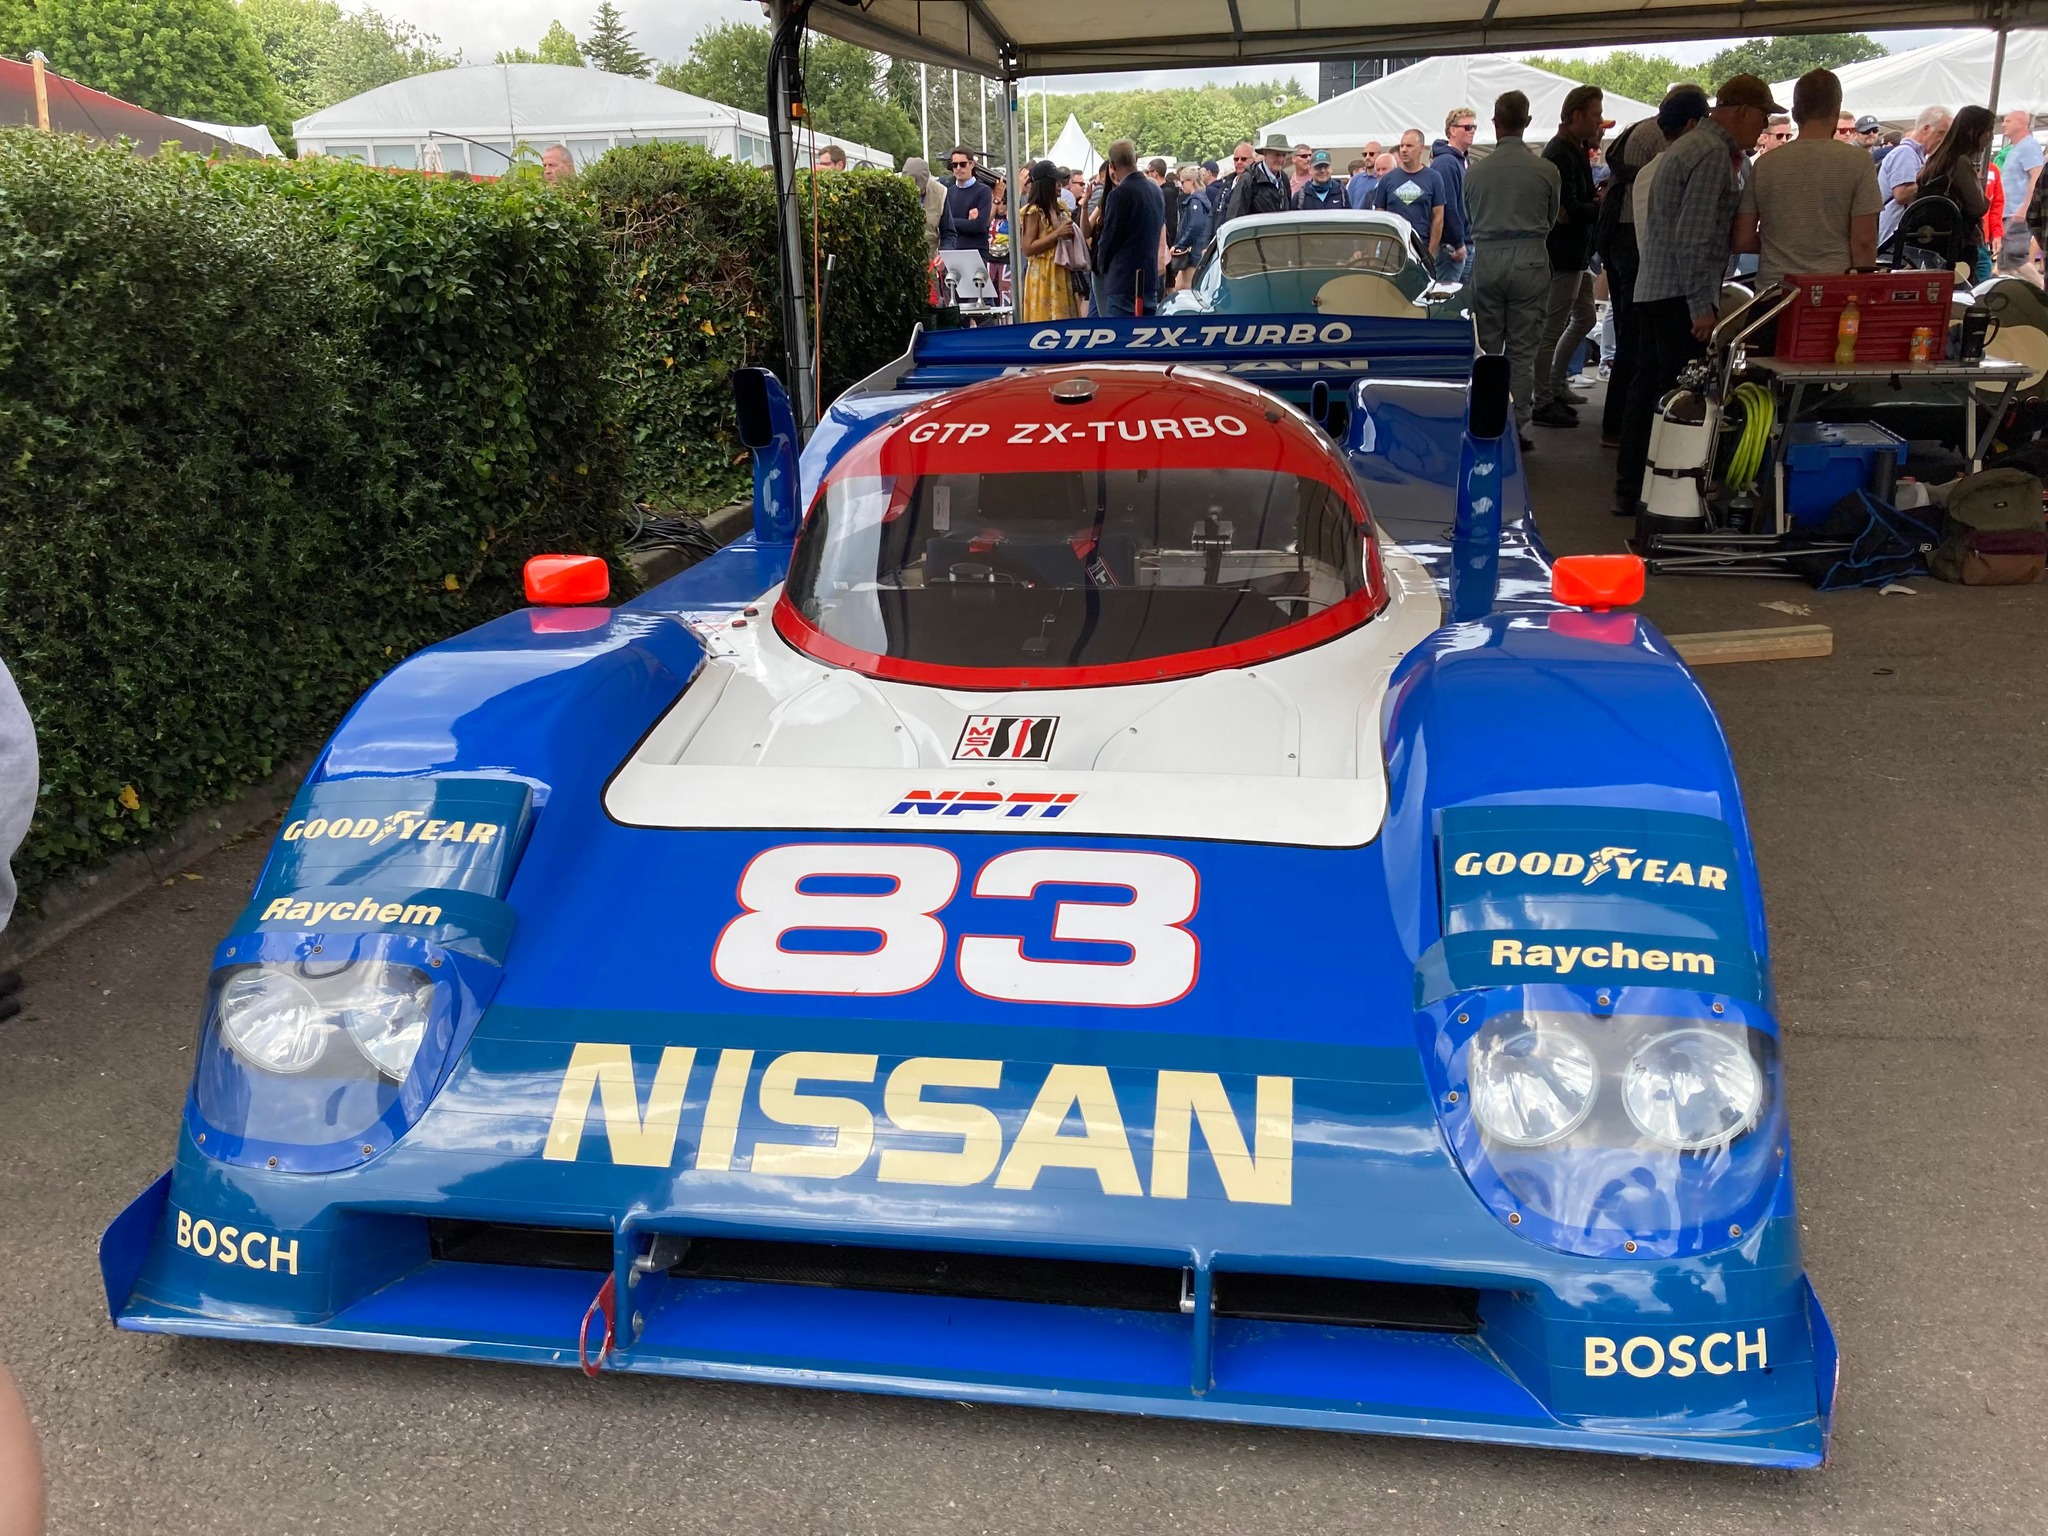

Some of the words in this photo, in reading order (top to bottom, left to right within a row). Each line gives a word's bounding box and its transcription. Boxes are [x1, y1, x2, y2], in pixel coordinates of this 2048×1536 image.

[1029, 329, 1116, 350] GTP
[1126, 322, 1351, 349] ZX-TURBO
[909, 423, 989, 444] GTP
[1008, 416, 1247, 445] ZX-TURBO
[961, 716, 995, 757] IMSA
[261, 897, 442, 926] Raychem
[711, 843, 1201, 1008] 83
[1490, 939, 1715, 975] Raychem
[542, 1042, 1293, 1205] NISSAN
[176, 1211, 298, 1275] BOSCH
[1584, 1328, 1767, 1378] BOSCH
